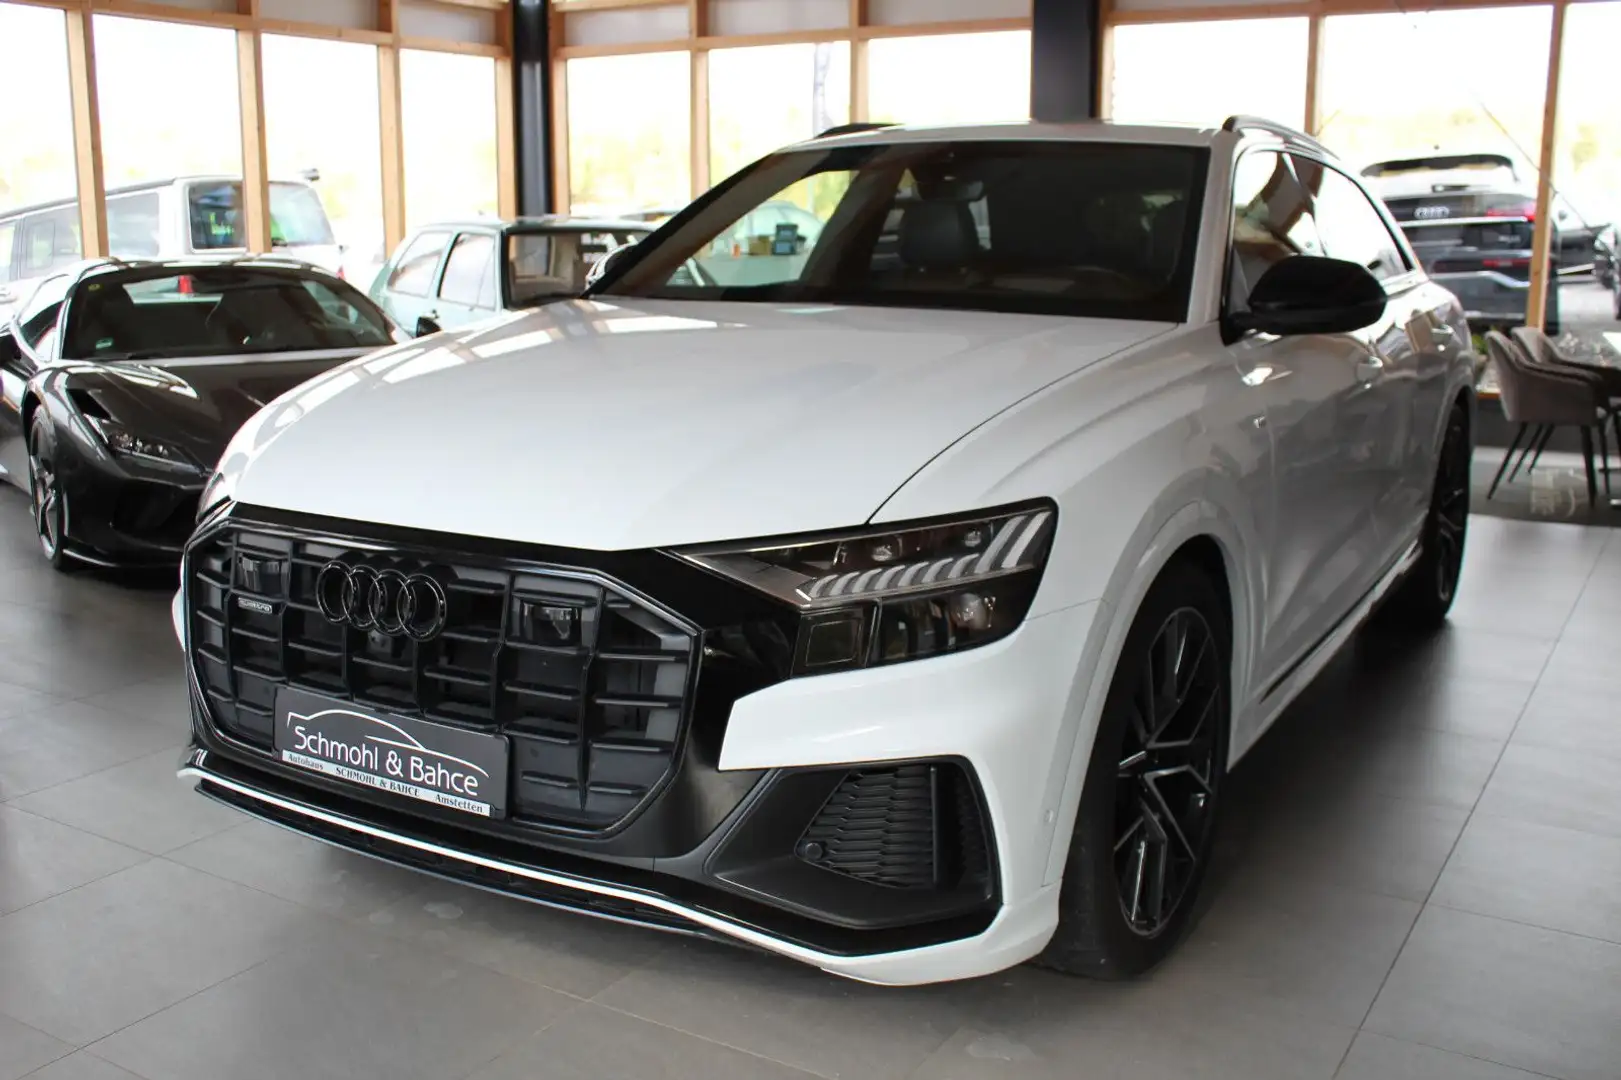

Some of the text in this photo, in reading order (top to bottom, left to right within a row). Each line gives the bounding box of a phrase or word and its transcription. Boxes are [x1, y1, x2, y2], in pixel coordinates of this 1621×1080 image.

[288, 753, 484, 813] Autohaus SCHMOHL & BAHCE Amstetten
[294, 726, 479, 796] Schmohl & Bahce
